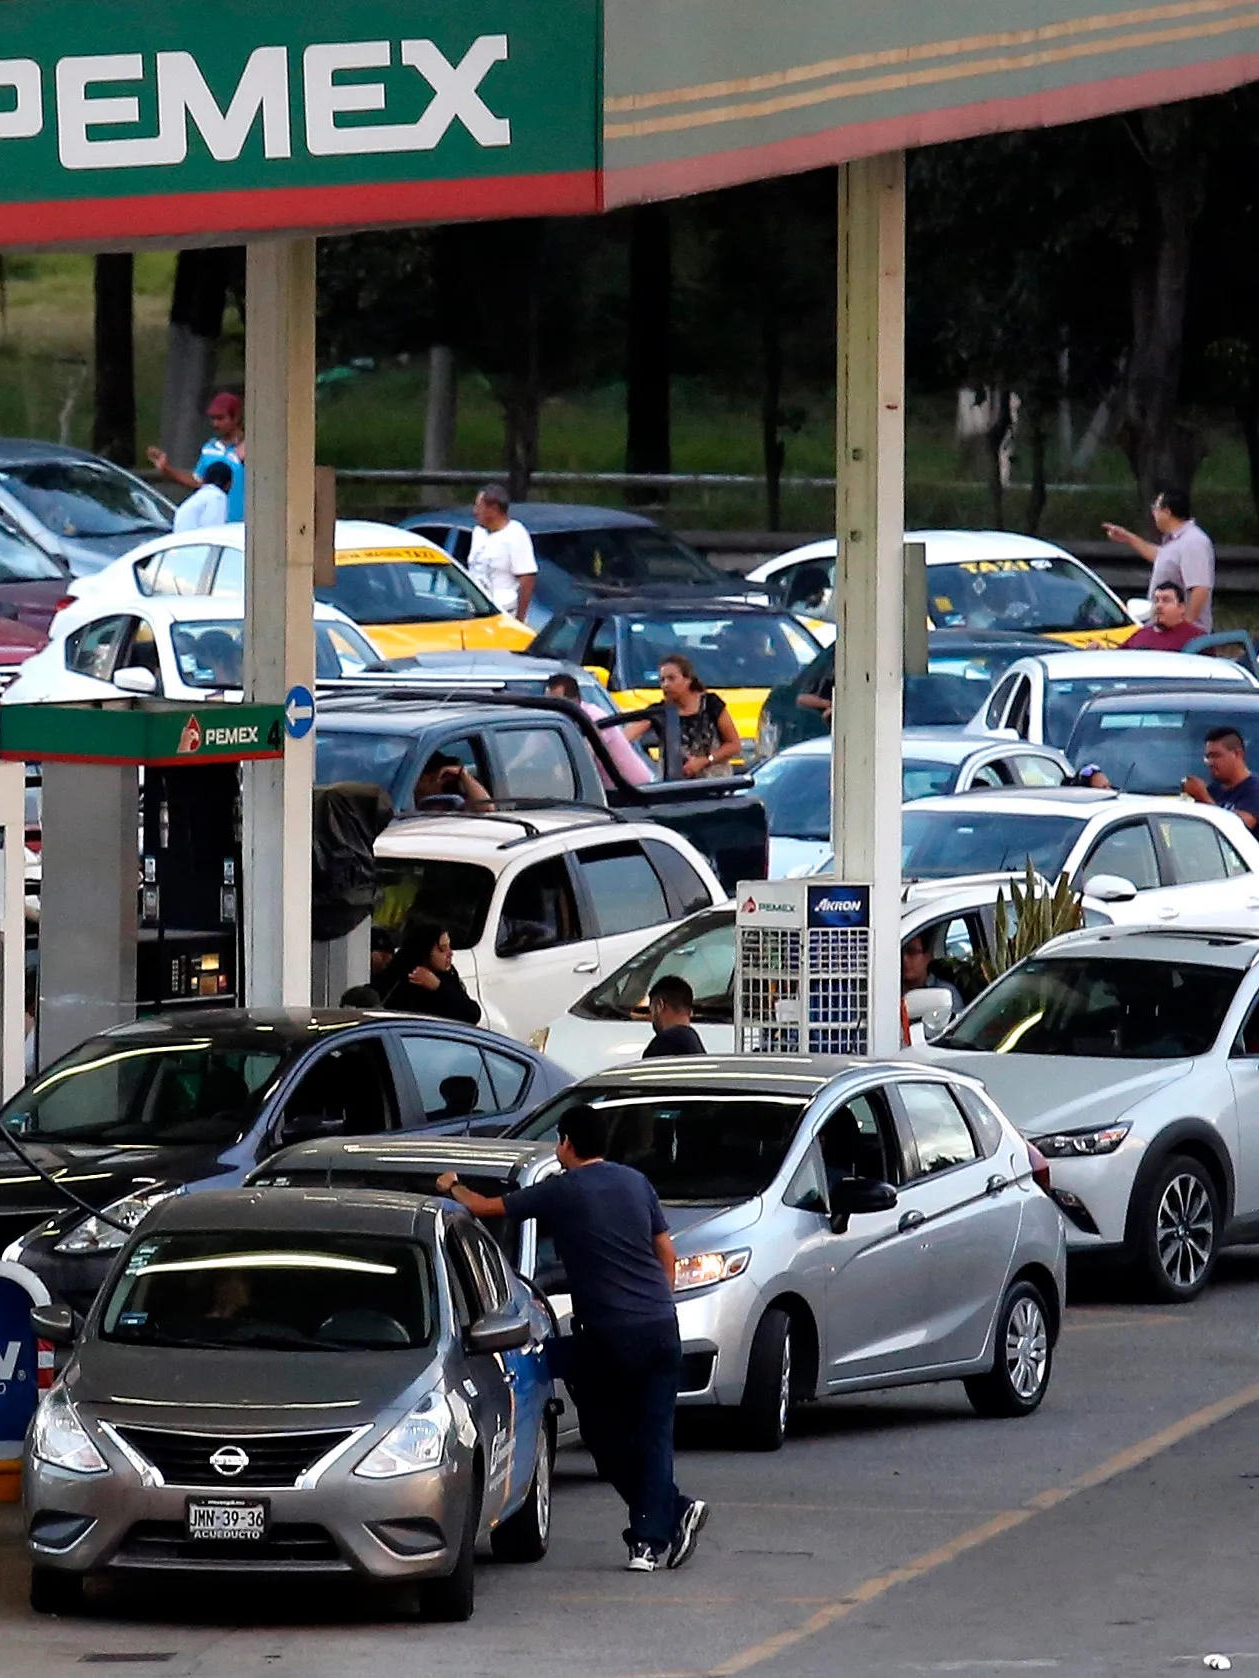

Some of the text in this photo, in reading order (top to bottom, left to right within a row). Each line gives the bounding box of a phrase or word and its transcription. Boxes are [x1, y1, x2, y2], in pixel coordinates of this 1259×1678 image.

[205, 726, 259, 746] PEMEX
[267, 719, 281, 751] 4
[758, 902, 796, 913] PEMEX
[814, 898, 862, 913] AKRON
[190, 1508, 264, 1528] JMN-39-36
[193, 1529, 261, 1540] ACUEDUCTO
